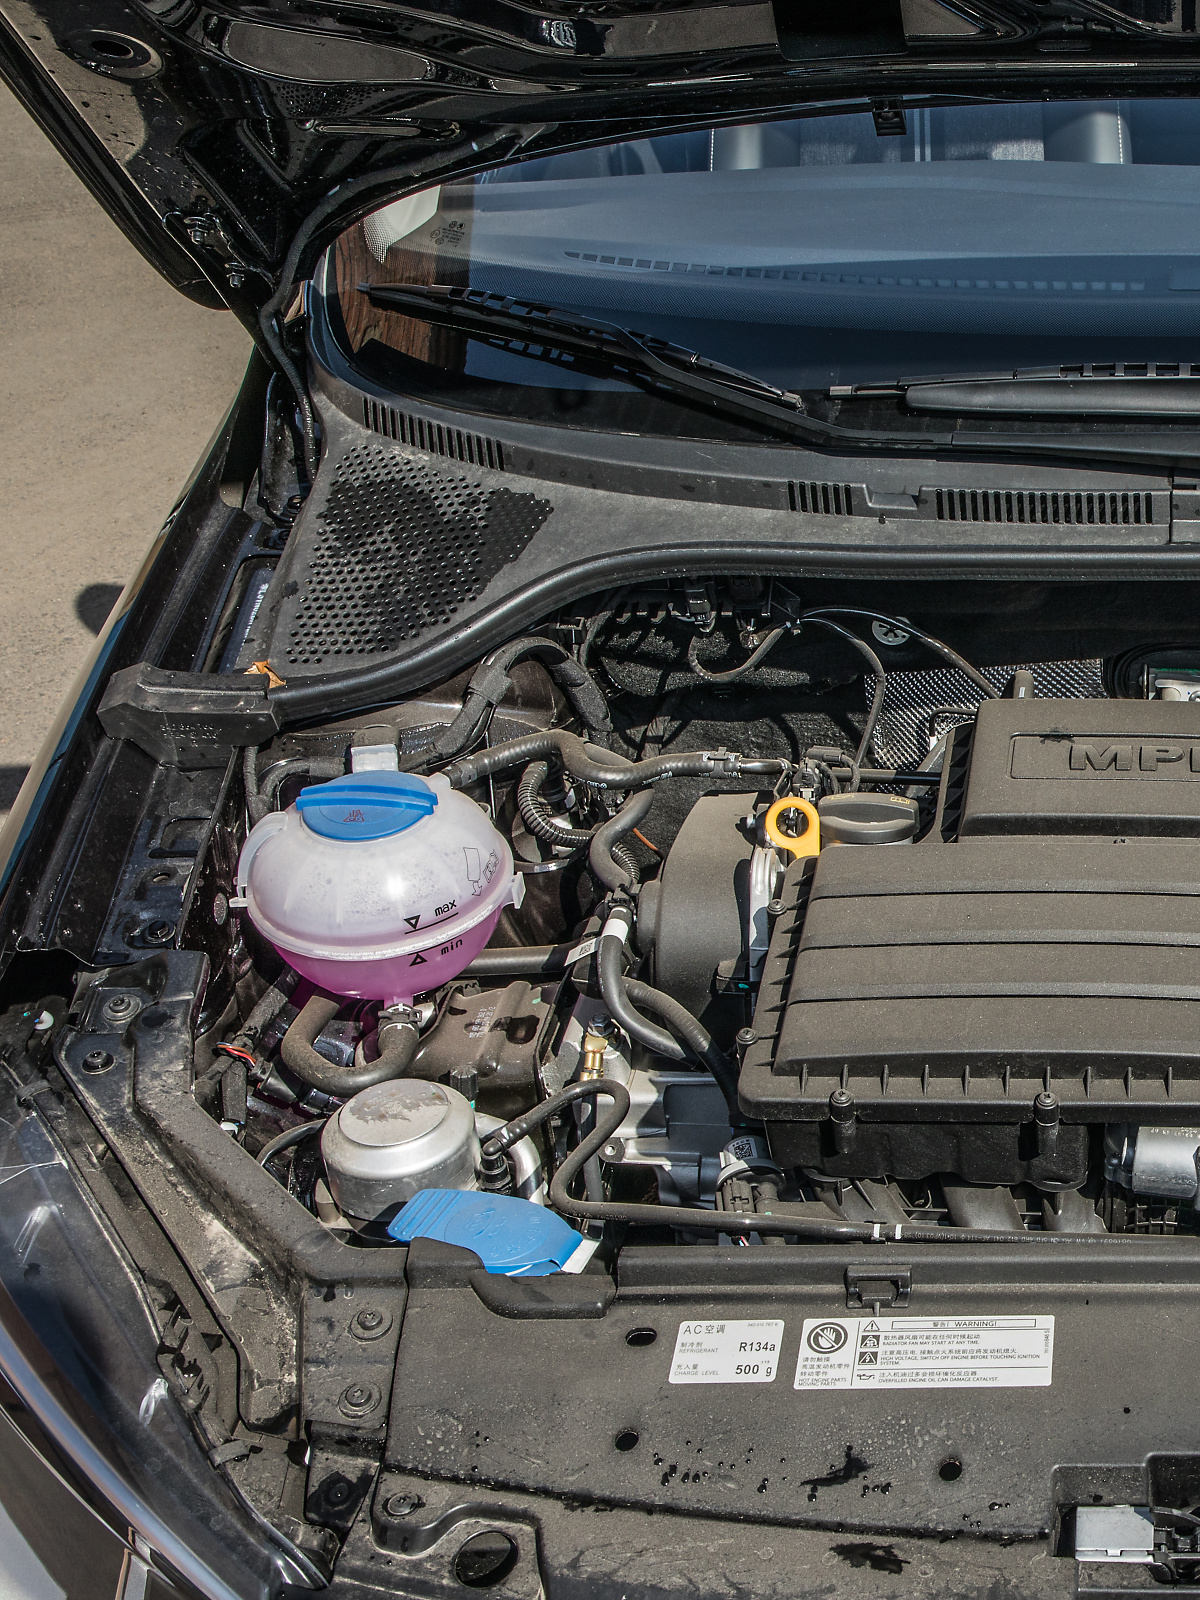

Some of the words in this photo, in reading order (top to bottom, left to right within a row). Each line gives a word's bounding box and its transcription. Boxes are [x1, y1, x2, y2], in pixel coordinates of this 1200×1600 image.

[434, 899, 458, 917] max
[440, 937, 464, 956] min
[738, 1341, 776, 1352] R134a
[735, 1364, 760, 1375] 500
[765, 1366, 772, 1377] g
